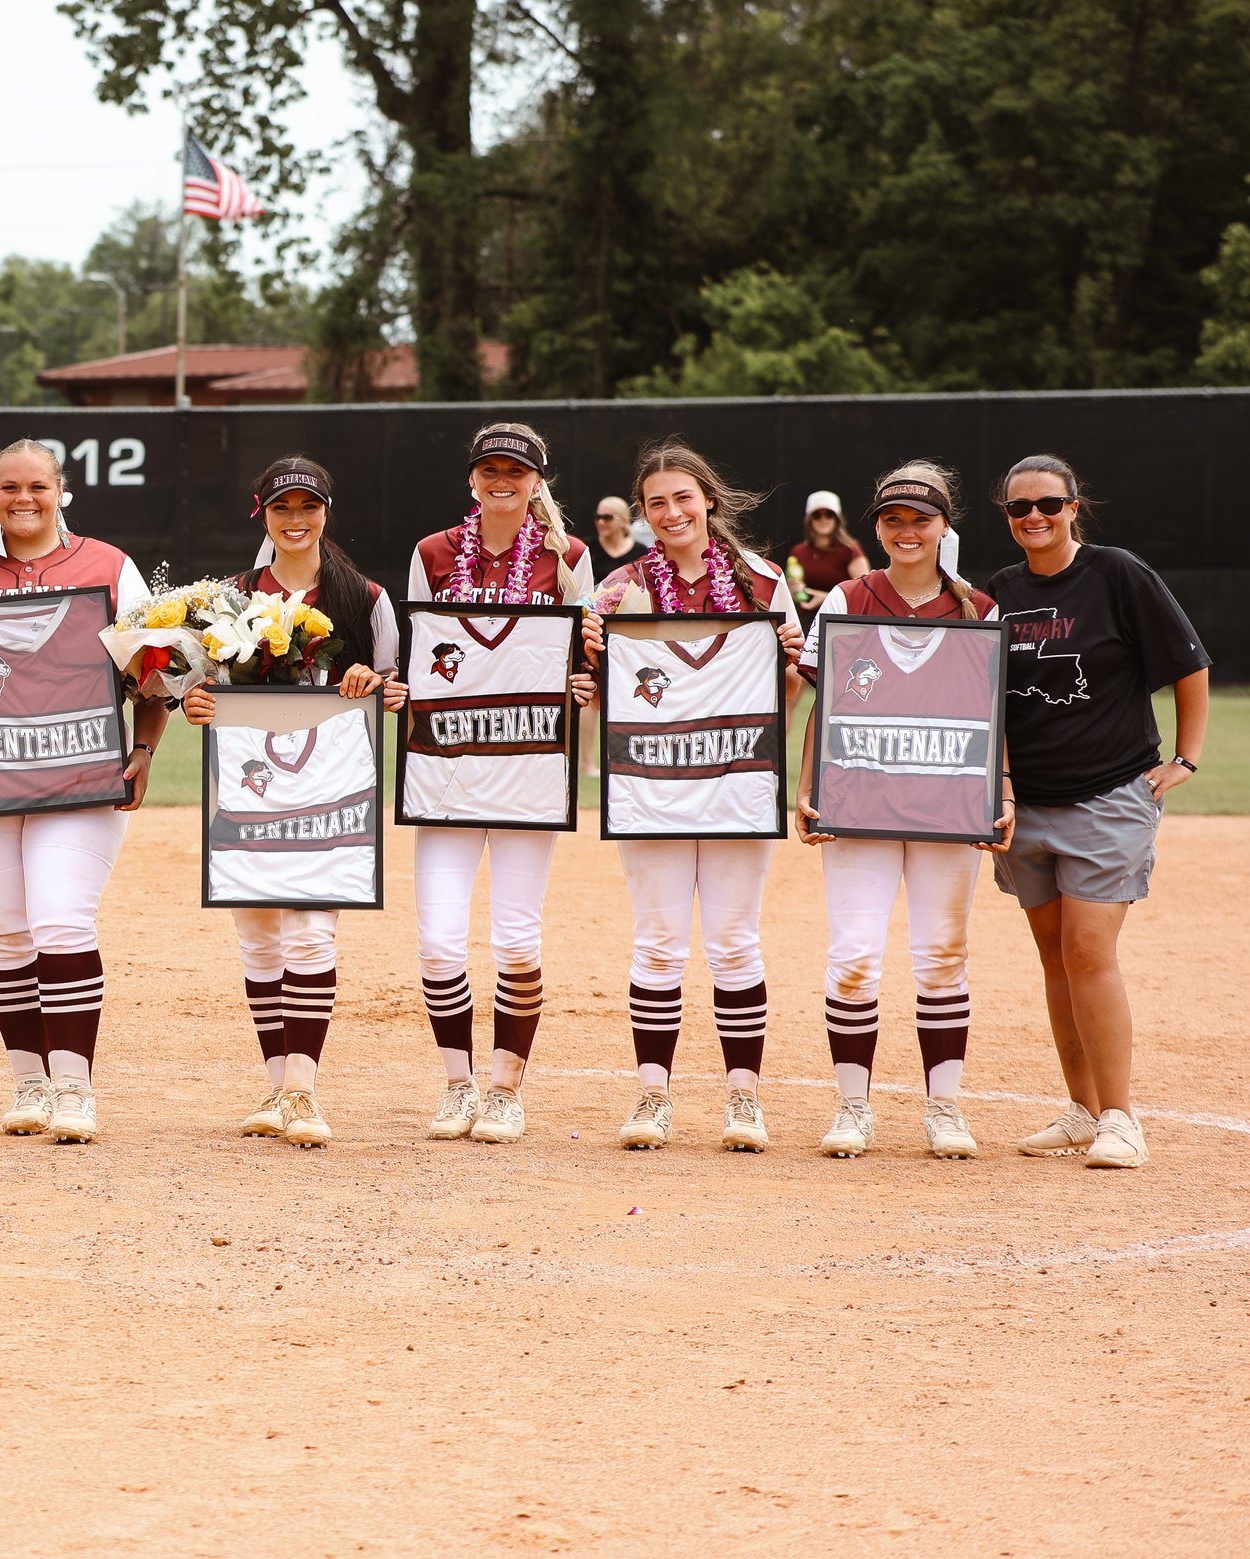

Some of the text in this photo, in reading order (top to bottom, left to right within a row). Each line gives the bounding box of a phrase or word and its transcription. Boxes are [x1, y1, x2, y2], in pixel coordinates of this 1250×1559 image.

[40, 438, 146, 487] 12
[481, 437, 530, 454] CENTENARY
[1008, 618, 1075, 642] TENARY
[1010, 642, 1036, 651] SOFTBALL
[430, 706, 561, 746] CENTENARY
[840, 726, 973, 763] CENTENARY
[628, 726, 764, 766] CENTENARY
